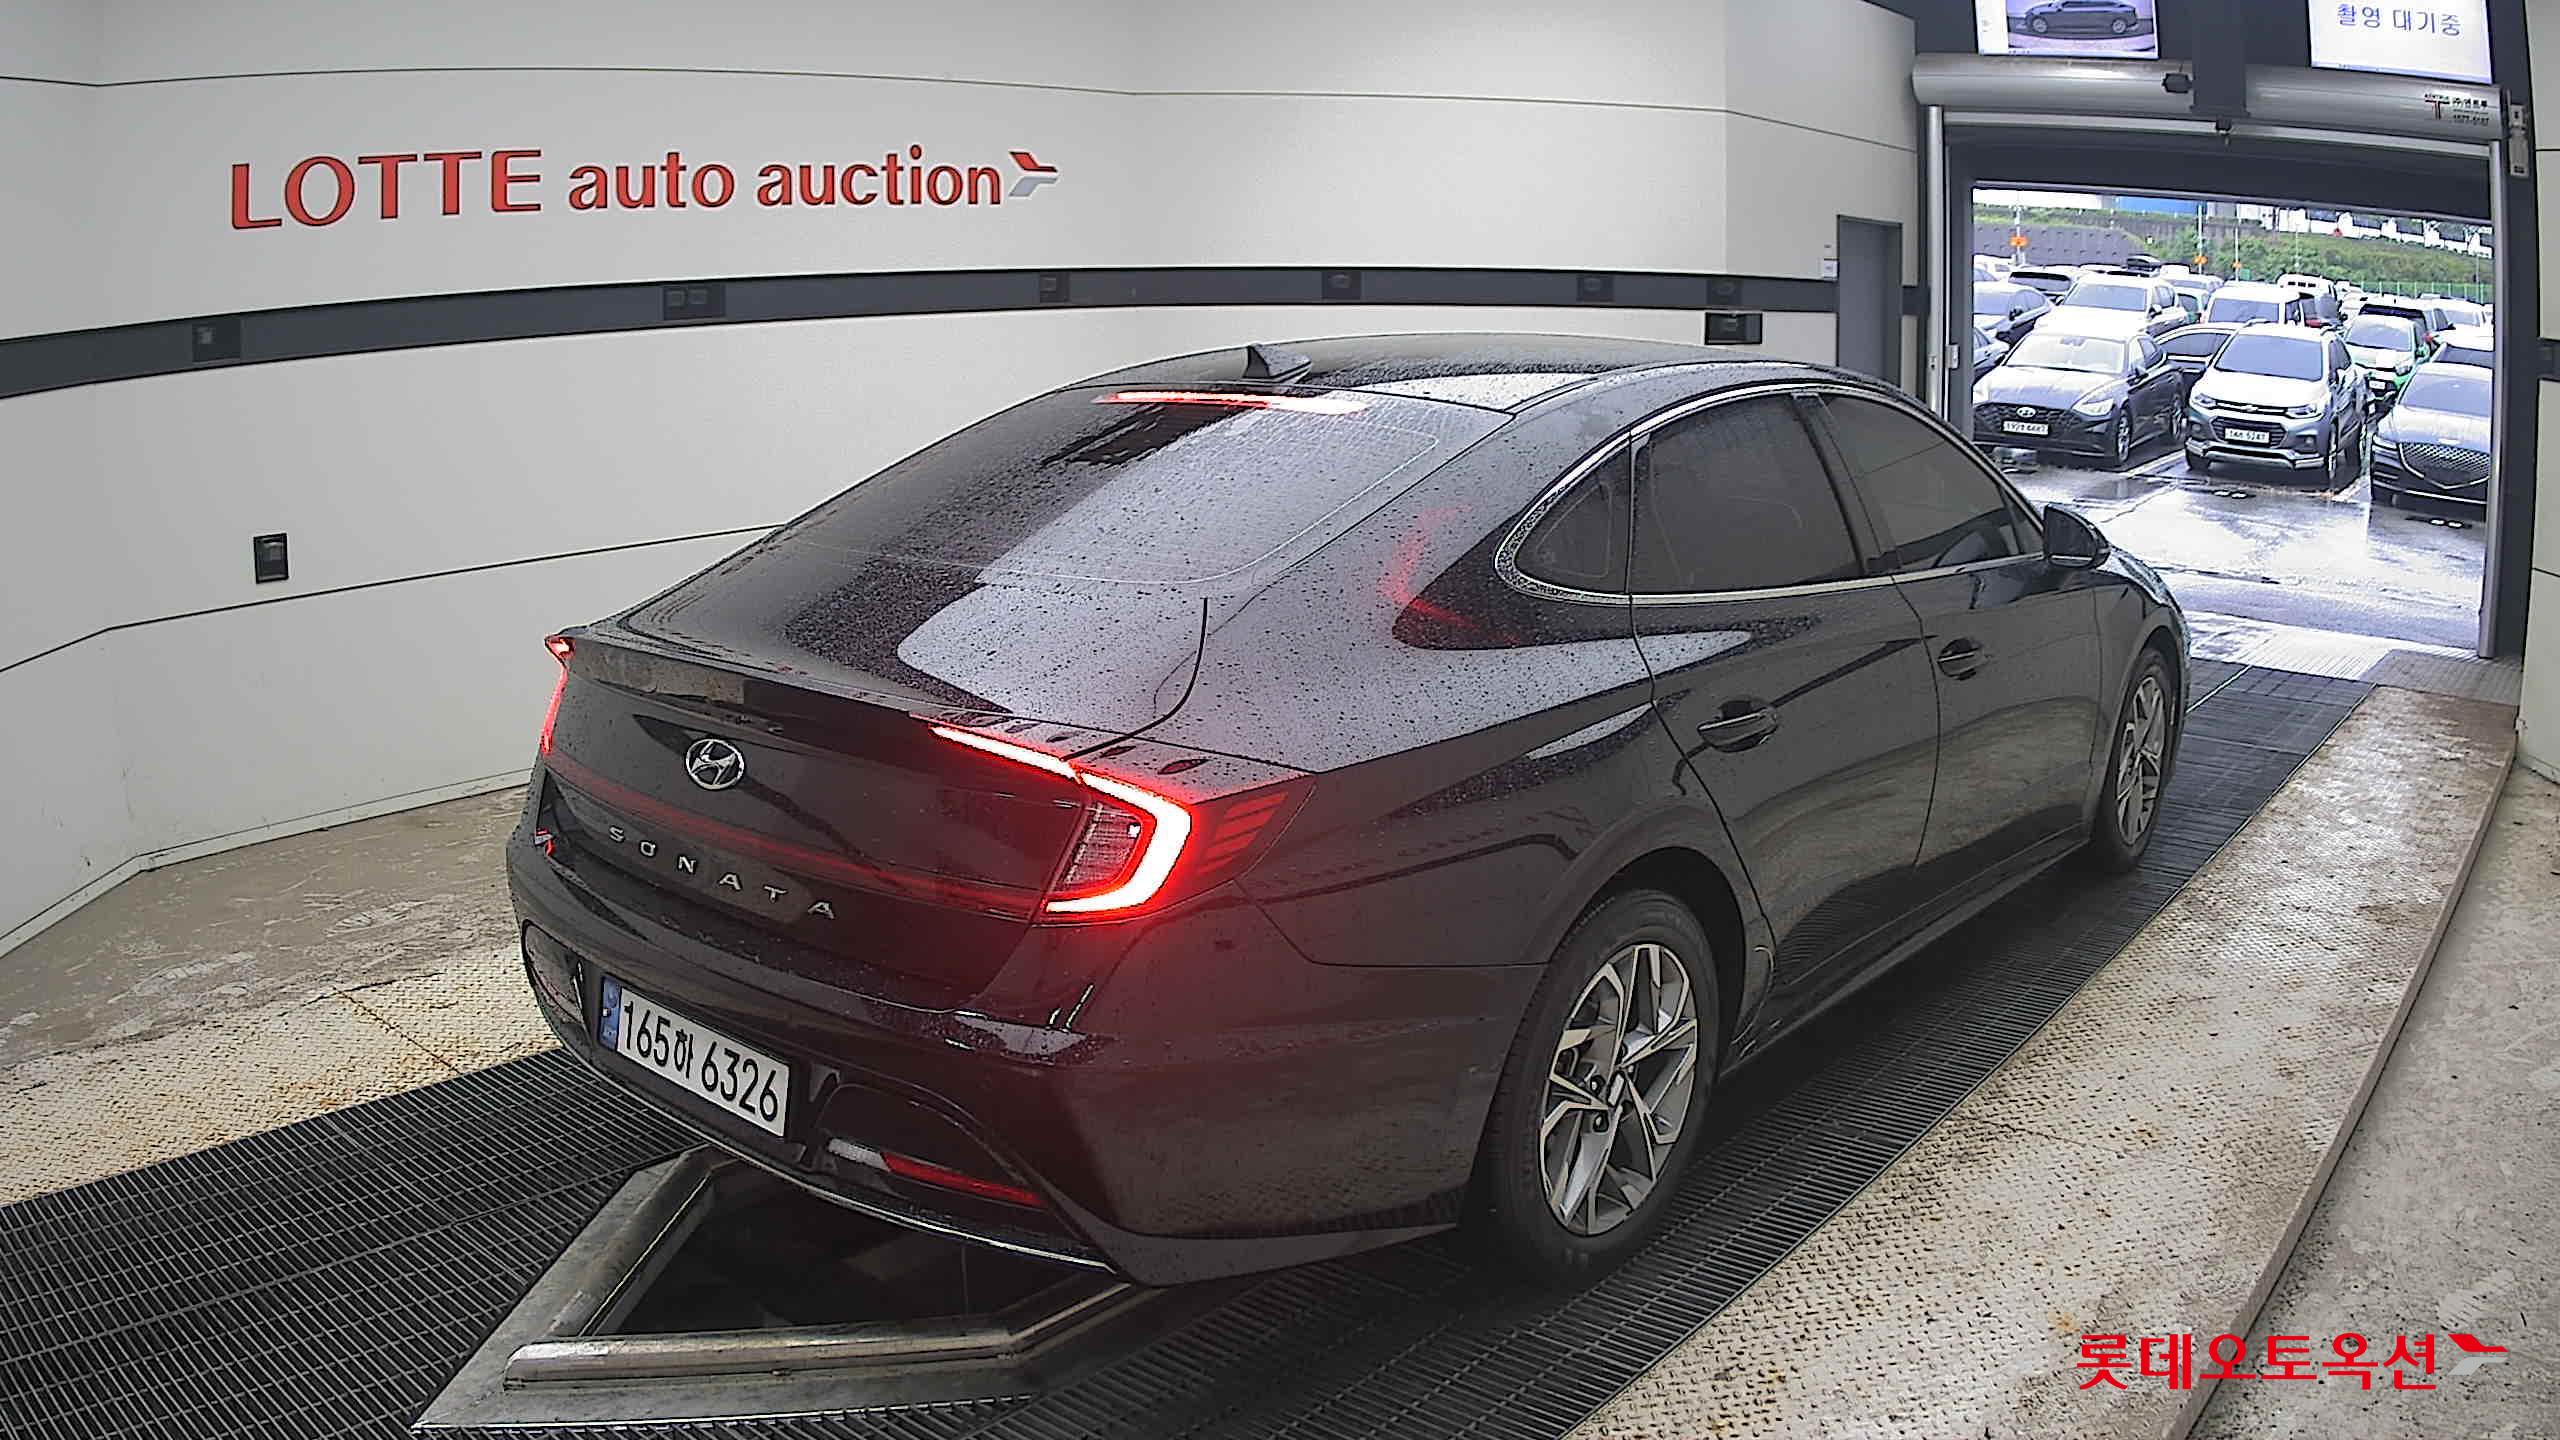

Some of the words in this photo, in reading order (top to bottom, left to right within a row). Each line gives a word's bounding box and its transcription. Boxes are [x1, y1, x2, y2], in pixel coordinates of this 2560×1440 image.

[2337, 3, 2382, 28] 촬영
[2391, 9, 2461, 36] 대기중
[231, 150, 540, 229] LOTTE
[568, 152, 736, 210] auto
[757, 146, 1002, 207] auction
[609, 826, 835, 920] SONATA
[623, 1000, 694, 1080] 165하
[701, 1041, 779, 1123] 6326
